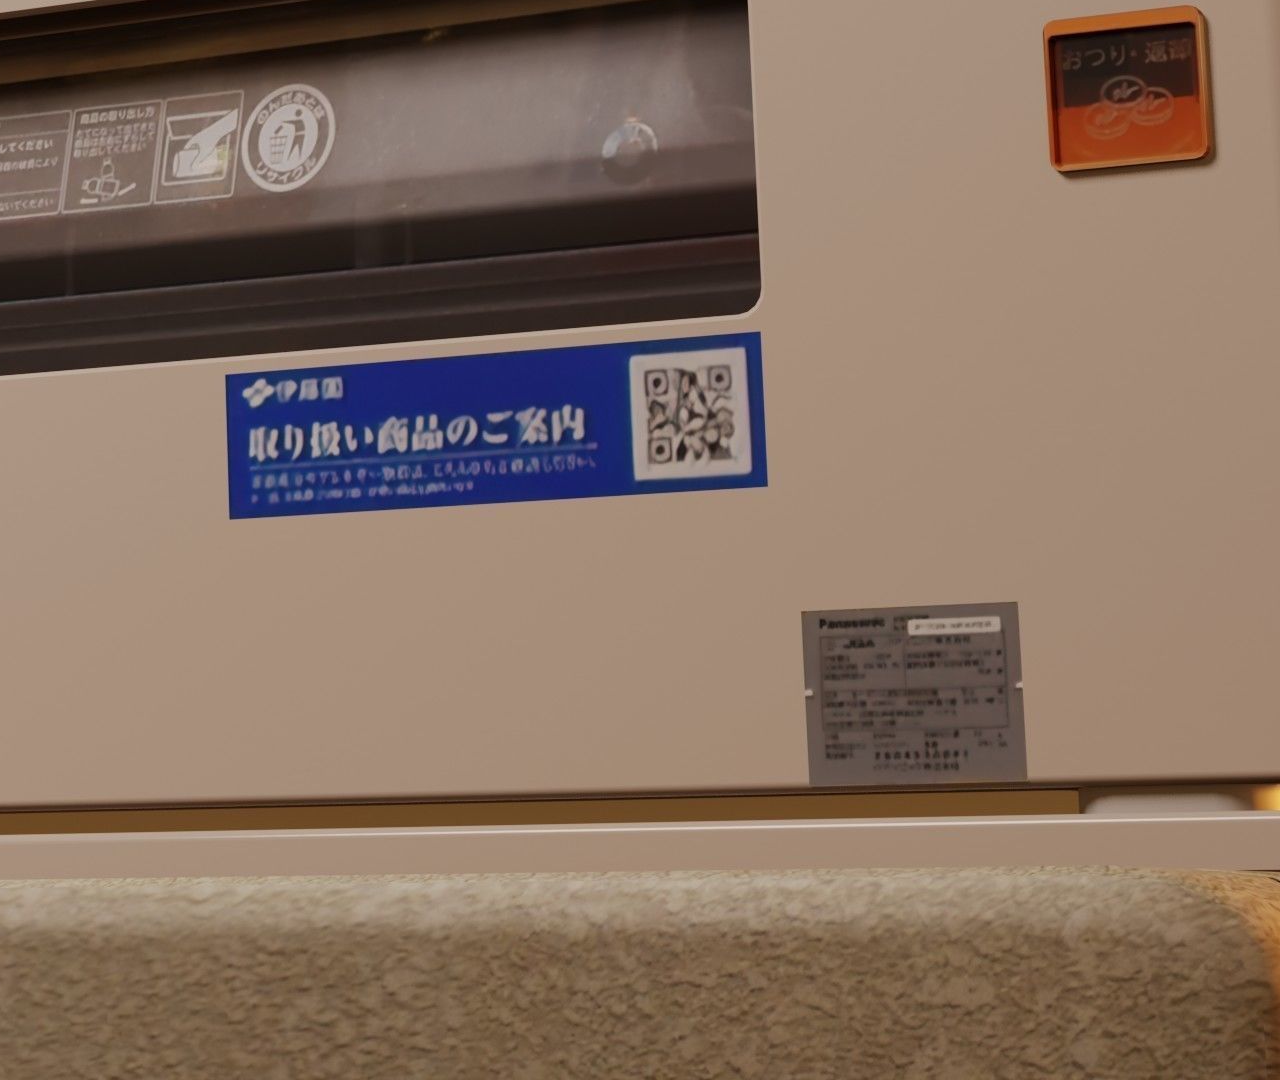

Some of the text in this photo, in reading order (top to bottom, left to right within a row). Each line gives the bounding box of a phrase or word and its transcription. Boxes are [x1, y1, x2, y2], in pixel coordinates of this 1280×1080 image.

[248, 404, 586, 463] 取り扱い商品のご案内
